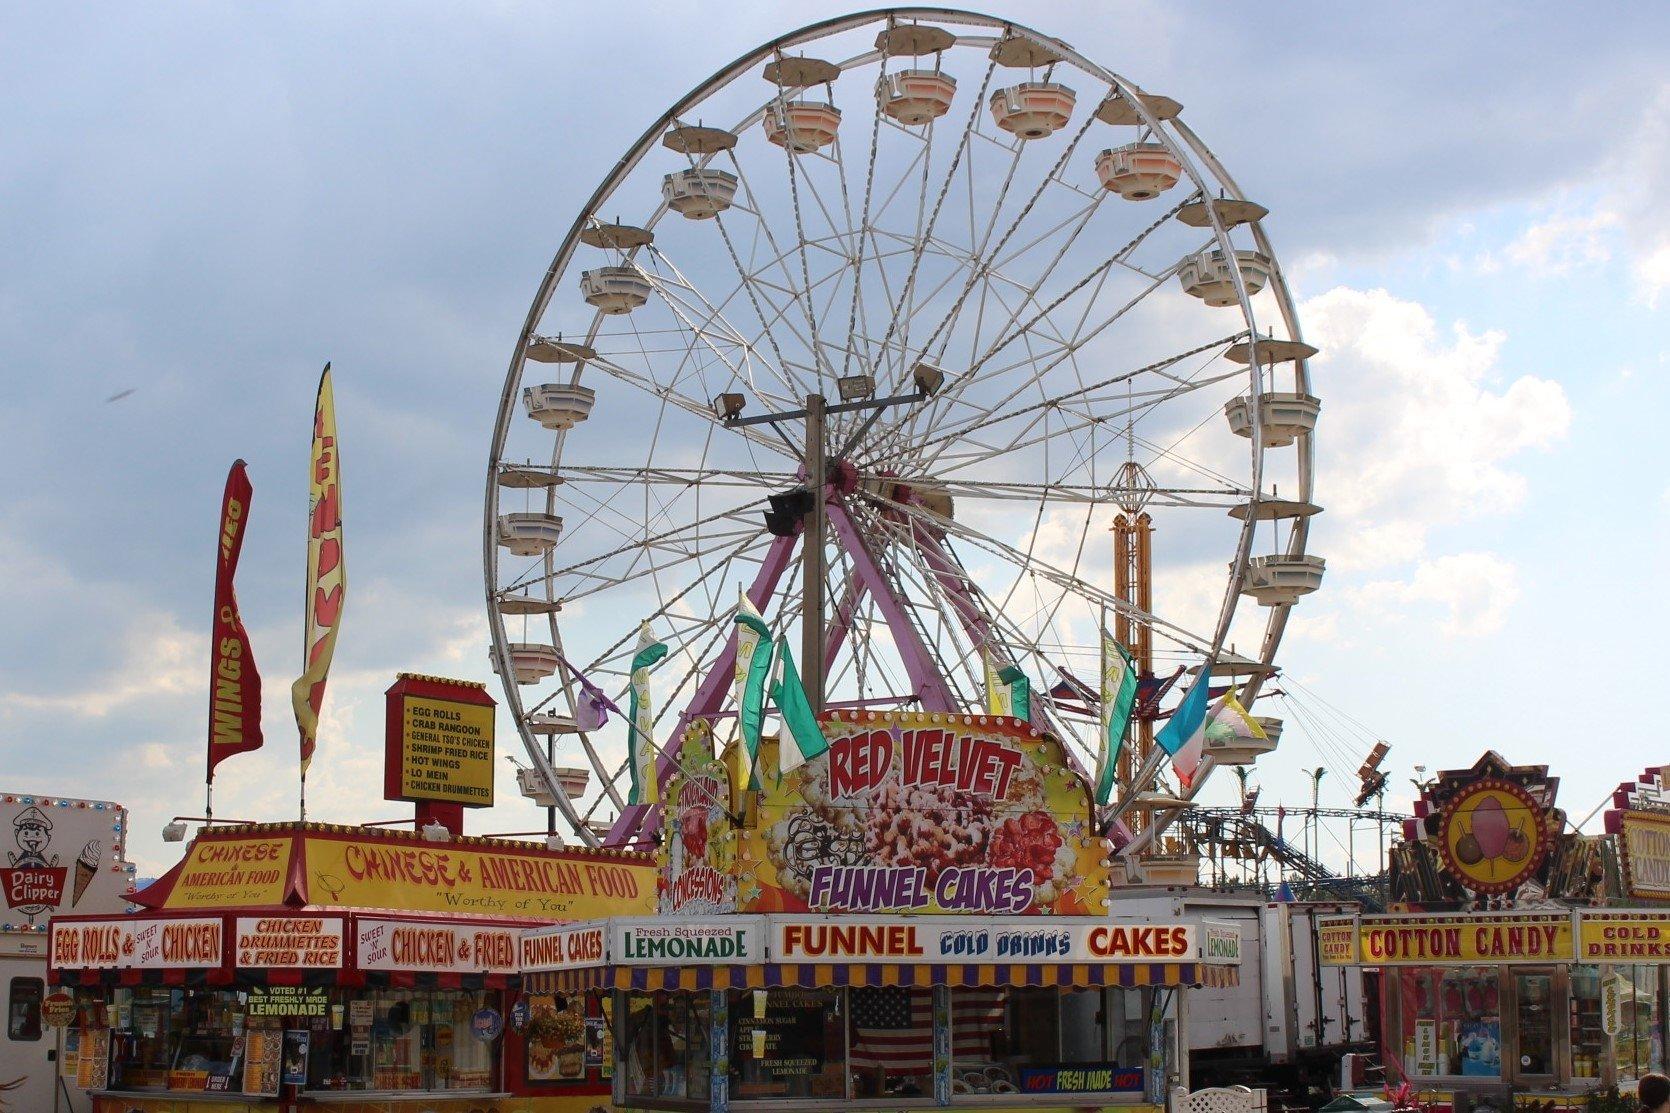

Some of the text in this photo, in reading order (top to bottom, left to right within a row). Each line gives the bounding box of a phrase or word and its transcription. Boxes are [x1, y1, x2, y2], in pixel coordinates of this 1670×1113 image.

[214, 636, 242, 744] WINGS
[412, 707, 461, 721] EGG ROLLS
[412, 720, 480, 735] CRAB RANGOON
[412, 731, 490, 749] GENERAL TSO'S CHICKEN
[412, 743, 488, 761] SHRIMP FRIED RICE
[411, 756, 460, 770] HOT WINGS
[827, 729, 1022, 801] RED VELVET
[410, 769, 448, 780] LO MEIN
[410, 781, 489, 797] CHICKEN DRUMMETTES
[199, 843, 283, 862] CHINESE
[11, 871, 54, 886] Dairy
[181, 870, 280, 887] AMERICAN FOOD
[346, 845, 638, 898] CHINESE & AMERICAN FOOD
[12, 885, 59, 901] Clipper
[672, 866, 724, 911] CONCESSIONS
[809, 865, 1034, 915] FUNNEL CAKES
[515, 898, 532, 910] of
[136, 924, 158, 944] SWEET
[256, 919, 323, 934] CHICKEN
[360, 925, 384, 944] SWEET
[635, 927, 732, 938] Fresh Squeezed
[1604, 927, 1660, 940] COLD
[55, 926, 135, 962] EGG ROLLS &
[162, 923, 220, 962] CHICKEN
[239, 935, 340, 949] DRUMMETTES
[625, 930, 747, 958] LEMONADE
[783, 925, 924, 957] FUNNEL
[940, 929, 1070, 957] COLD DRINKS
[1087, 927, 1188, 957] CAKES
[1207, 932, 1238, 957] LEMONADE
[1322, 932, 1352, 942] COTTON
[1370, 926, 1559, 958] COTTON CANDY
[141, 947, 160, 963] SOUR
[368, 948, 387, 964] SOUR
[392, 928, 514, 967] CHICKEN & FRIED
[523, 930, 602, 965] FUNNEL CAKES
[1324, 943, 1350, 954] CANDY
[1588, 943, 1670, 956] DRINKS
[240, 951, 339, 965] & FRIED RICE
[270, 987, 307, 995] VOTED #1
[248, 996, 328, 1004] BEST FRESHLY MADE
[250, 1004, 326, 1016] LEMONADE
[1056, 1070, 1085, 1090] FRESH
[1086, 1070, 1112, 1090] MADE
